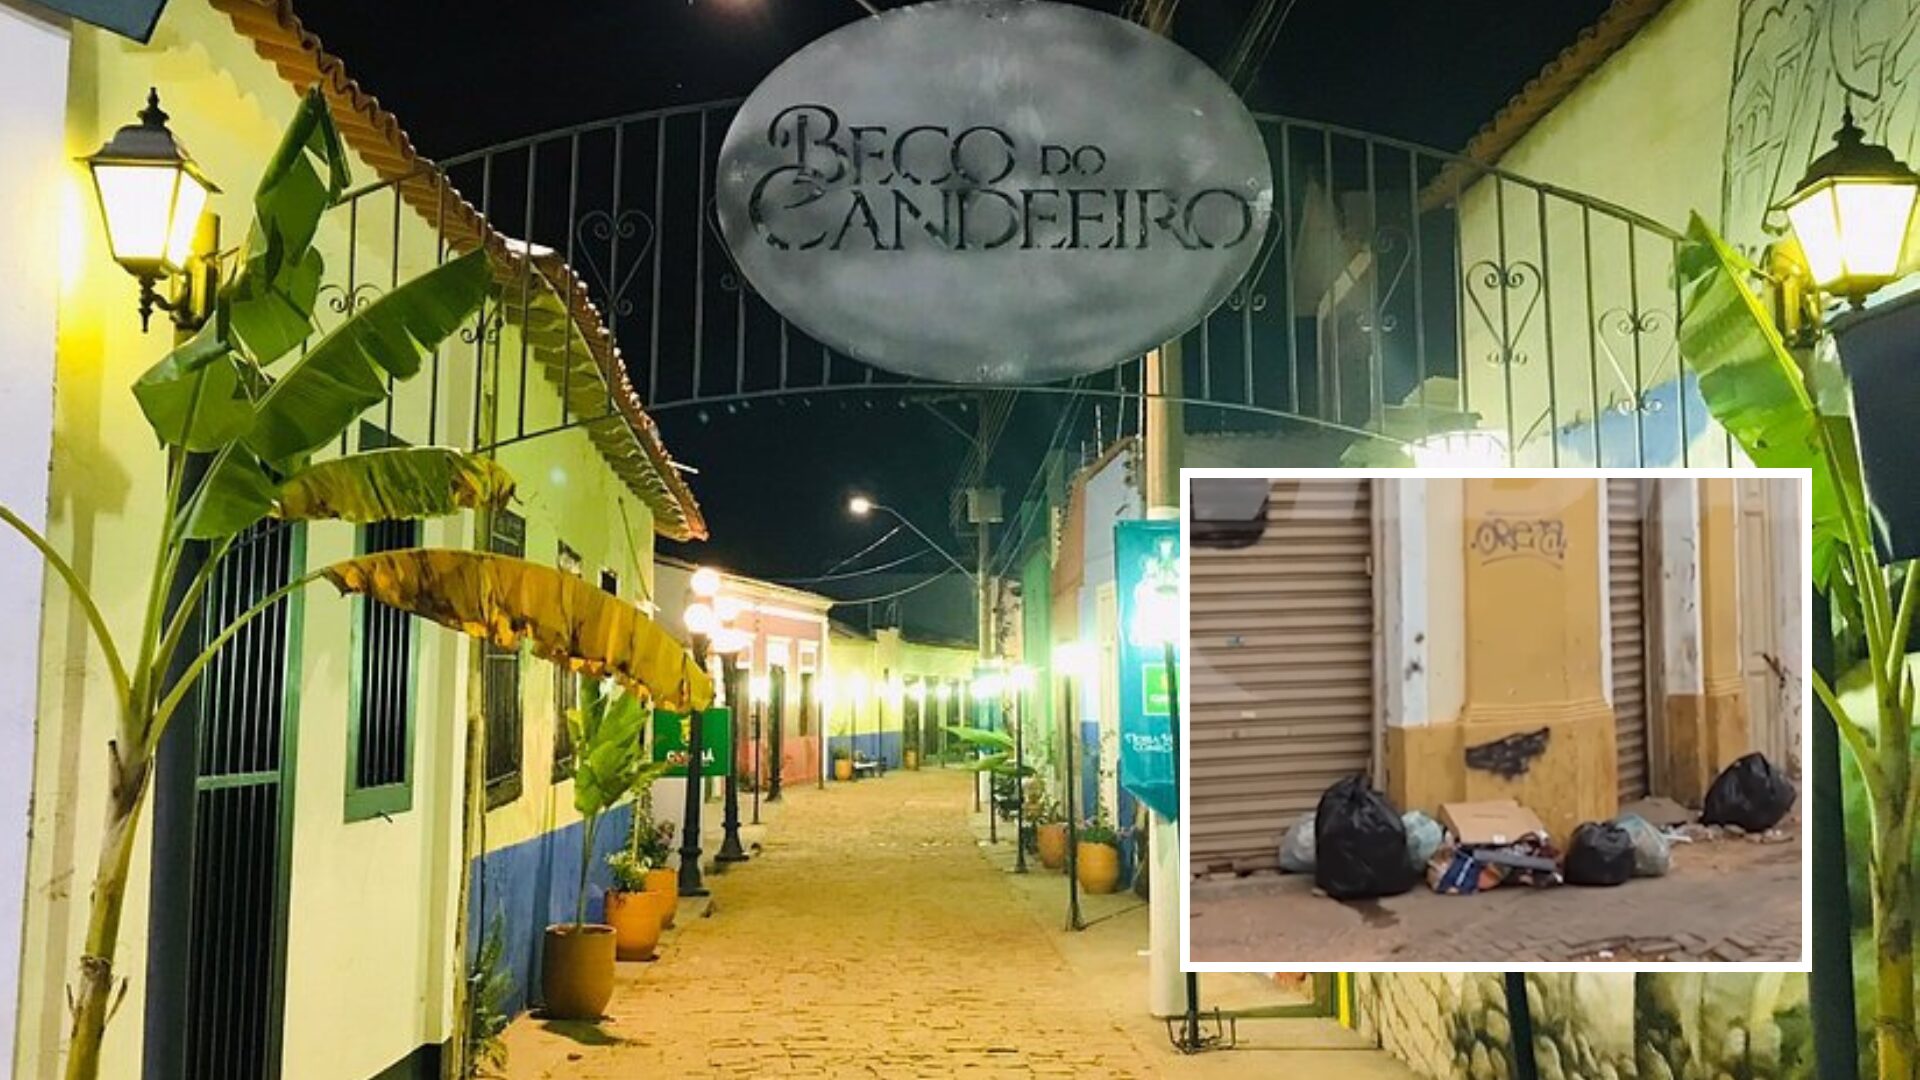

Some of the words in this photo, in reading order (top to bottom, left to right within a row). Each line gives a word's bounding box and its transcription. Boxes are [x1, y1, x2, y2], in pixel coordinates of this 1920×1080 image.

[768, 104, 1015, 184] BECO
[1040, 145, 1106, 176] DO
[748, 165, 1252, 250] CANDEEIRO
